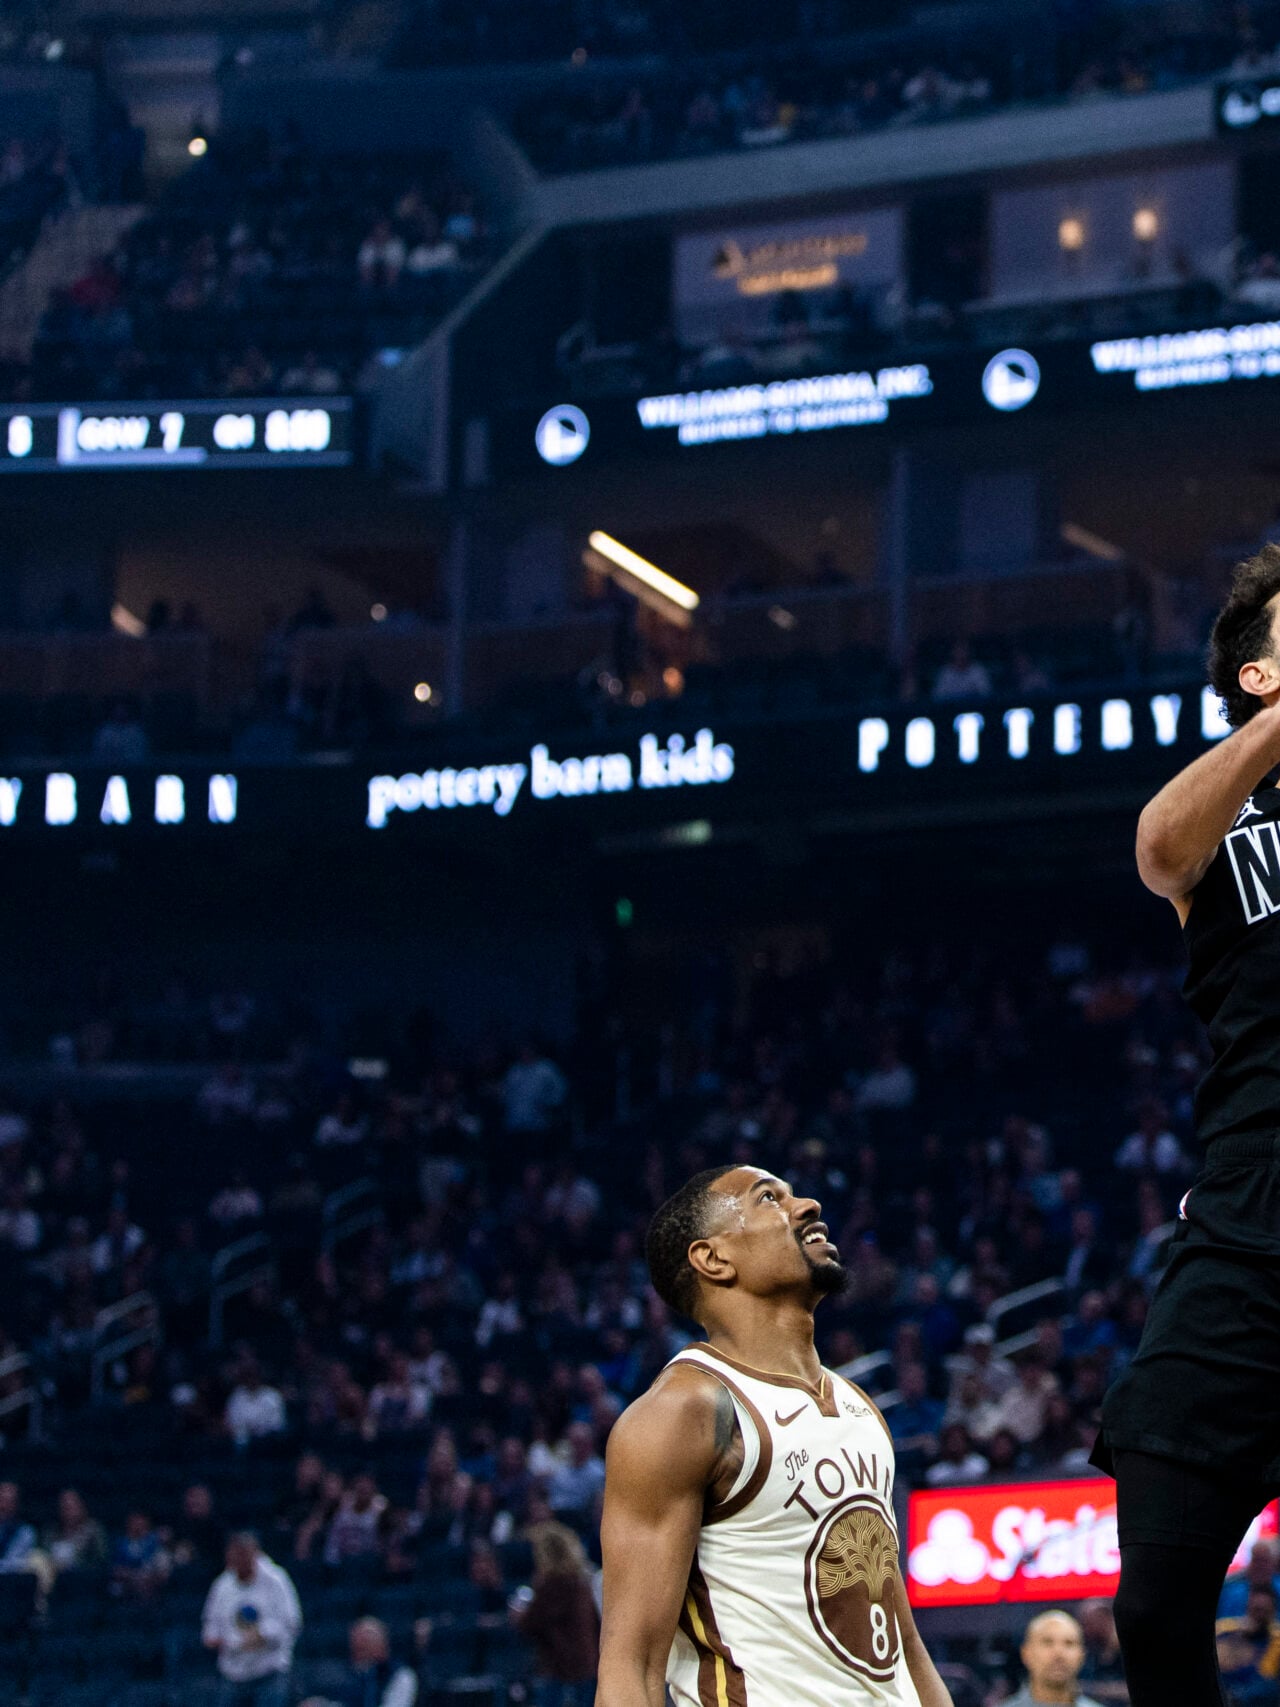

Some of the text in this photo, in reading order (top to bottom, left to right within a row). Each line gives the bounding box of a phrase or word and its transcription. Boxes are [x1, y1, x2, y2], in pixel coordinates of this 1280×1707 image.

[858, 694, 1183, 772] POTTERY
[366, 728, 735, 829] pottery barn kids
[784, 1447, 810, 1481] The
[869, 1603, 889, 1660] 8
